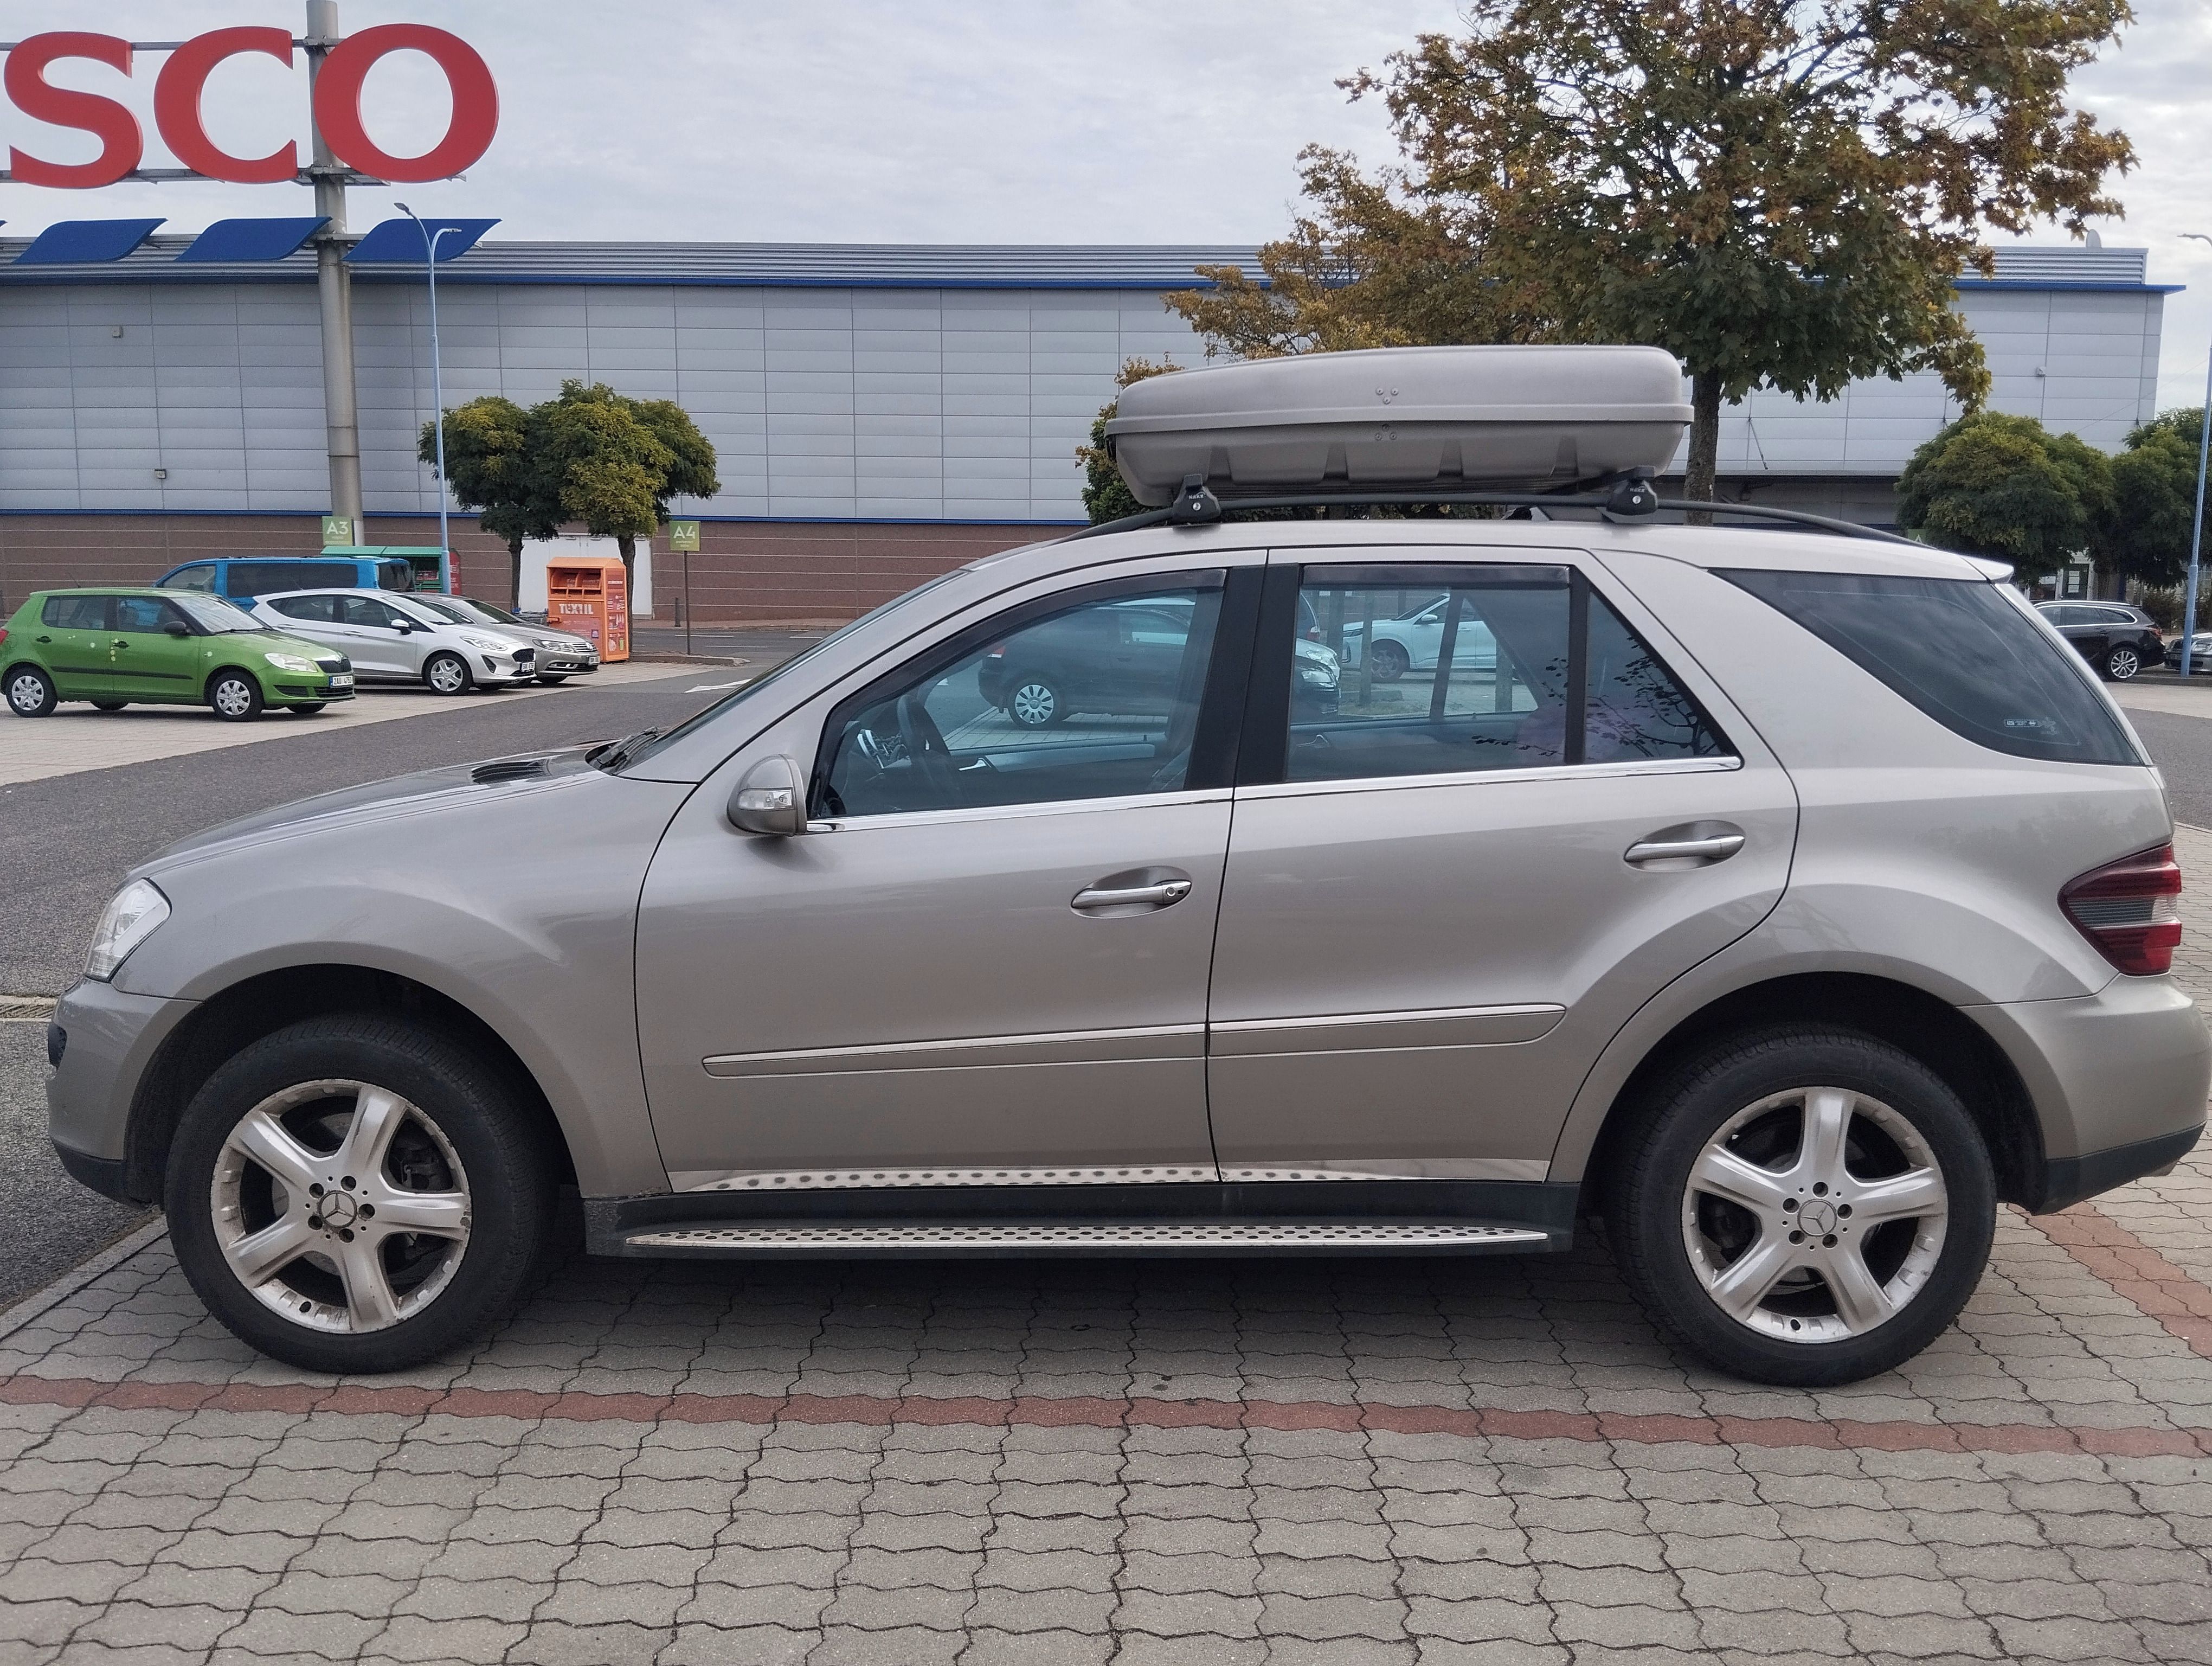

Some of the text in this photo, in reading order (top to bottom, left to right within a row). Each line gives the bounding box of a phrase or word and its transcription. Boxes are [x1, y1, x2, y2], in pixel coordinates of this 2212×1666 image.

[3, 23, 500, 189] SCO
[326, 521, 349, 535] A3
[673, 525, 695, 539] A4
[558, 604, 594, 614] TEXTIL
